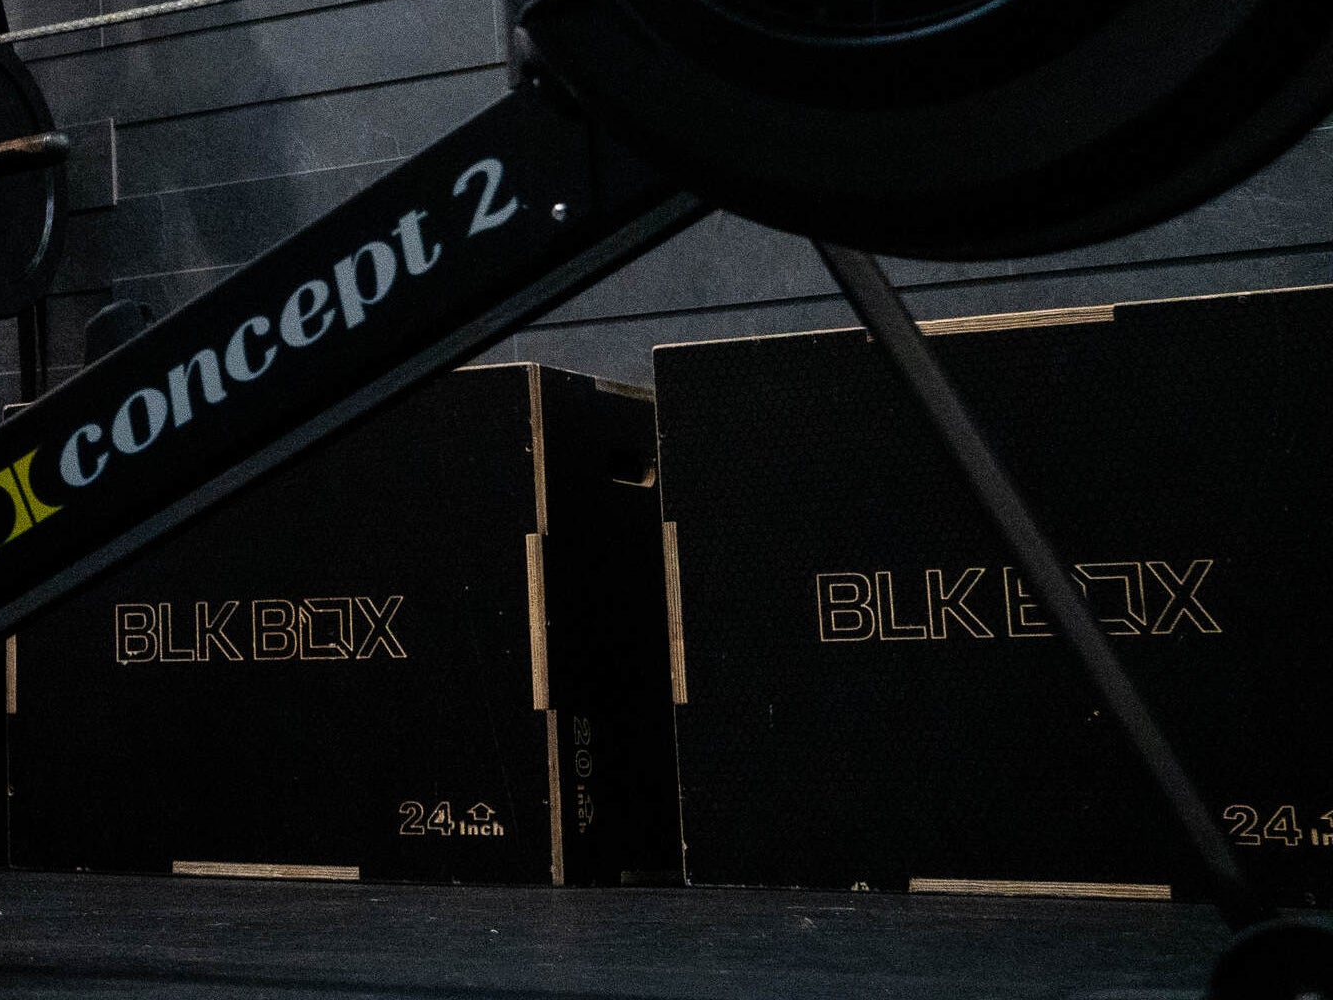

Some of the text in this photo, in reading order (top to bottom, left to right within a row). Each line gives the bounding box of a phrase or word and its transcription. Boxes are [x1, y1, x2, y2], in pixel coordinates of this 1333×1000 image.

[59, 156, 520, 489] concept 2
[115, 594, 408, 664] BLK BOX
[815, 567, 995, 643] BLK
[398, 800, 505, 836] 24 Inch
[1223, 804, 1303, 846] 24
